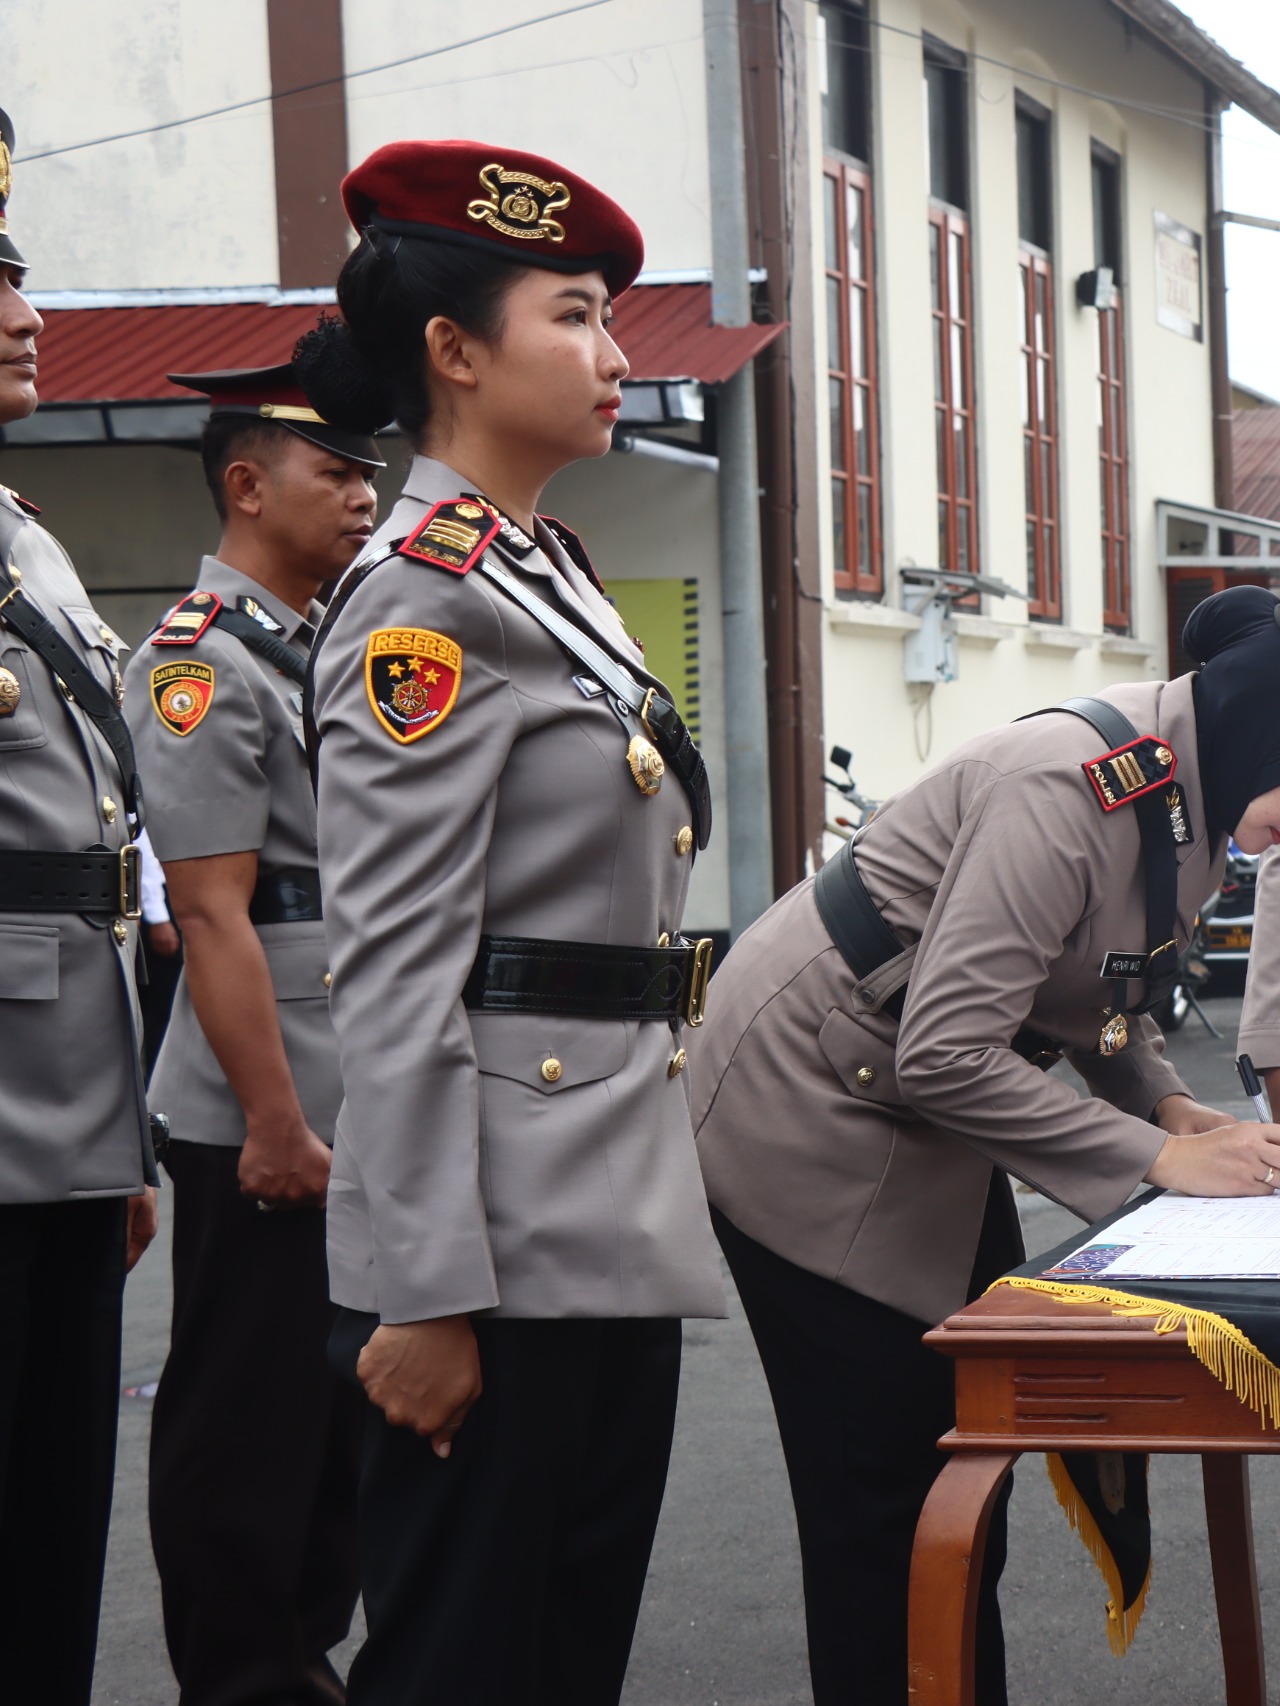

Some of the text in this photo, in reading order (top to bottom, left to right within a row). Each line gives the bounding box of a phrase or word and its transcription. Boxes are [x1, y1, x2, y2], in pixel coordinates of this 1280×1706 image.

[156, 634, 194, 642] POLISI
[374, 633, 458, 665] RESERSE
[155, 665, 210, 682] SATINTELKAM
[1090, 763, 1117, 805] POLISI
